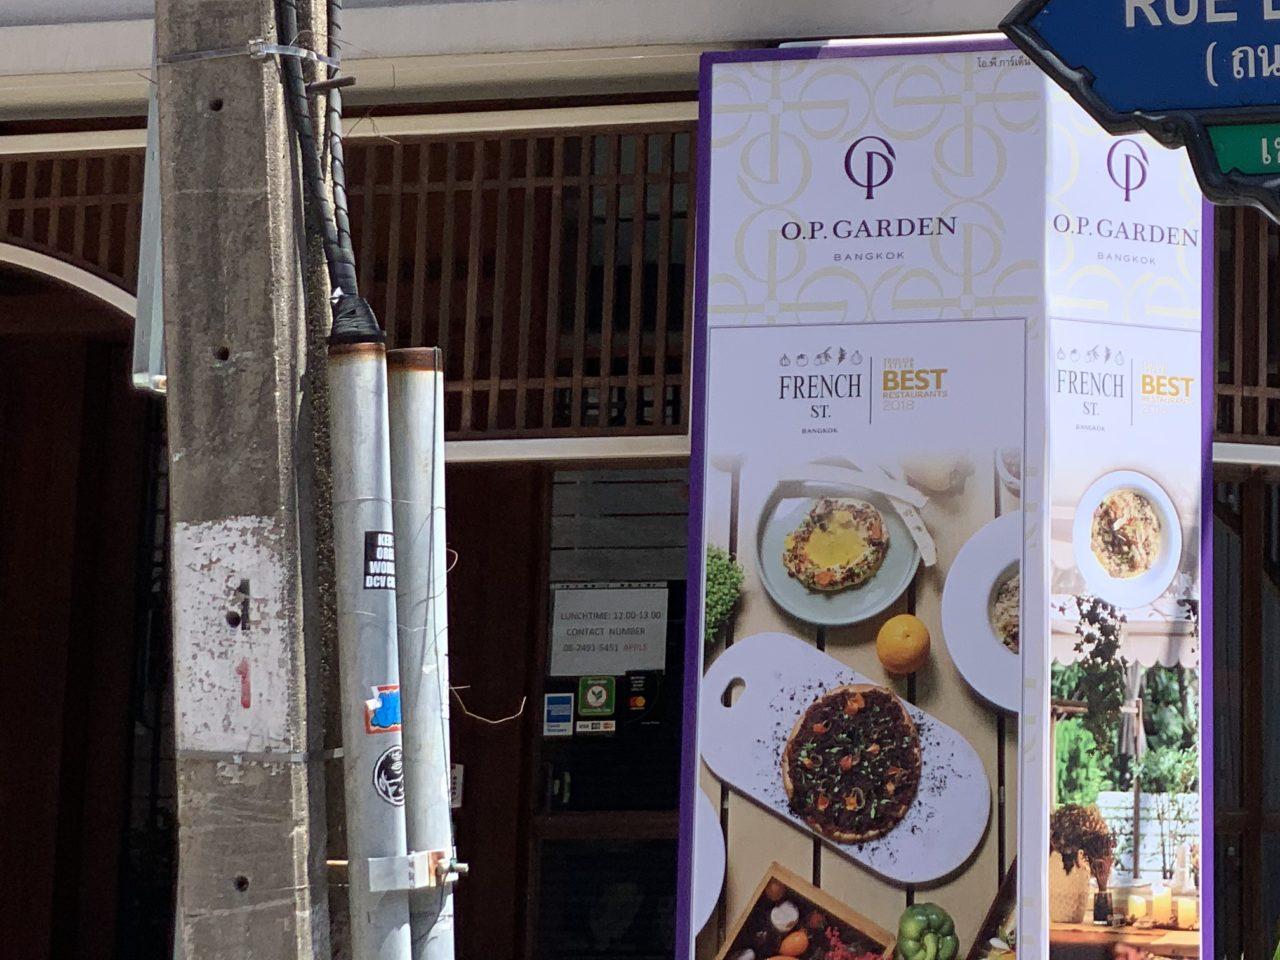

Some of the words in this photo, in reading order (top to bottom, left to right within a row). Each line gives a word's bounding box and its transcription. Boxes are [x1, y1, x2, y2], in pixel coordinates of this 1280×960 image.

[834, 251, 904, 261] BANGKOK
[1097, 251, 1156, 265] BANGKOK
[779, 373, 863, 399] FRENCH
[882, 369, 948, 391] BEST
[1057, 369, 1125, 398] FRENCH
[1141, 373, 1194, 397] BEST
[882, 390, 948, 400] RESTAURANTS
[810, 404, 831, 419] ST.
[883, 400, 915, 411] 2018
[1082, 401, 1100, 416] ST.
[566, 628, 605, 637] CONTACT
[609, 627, 646, 636] NUMBER
